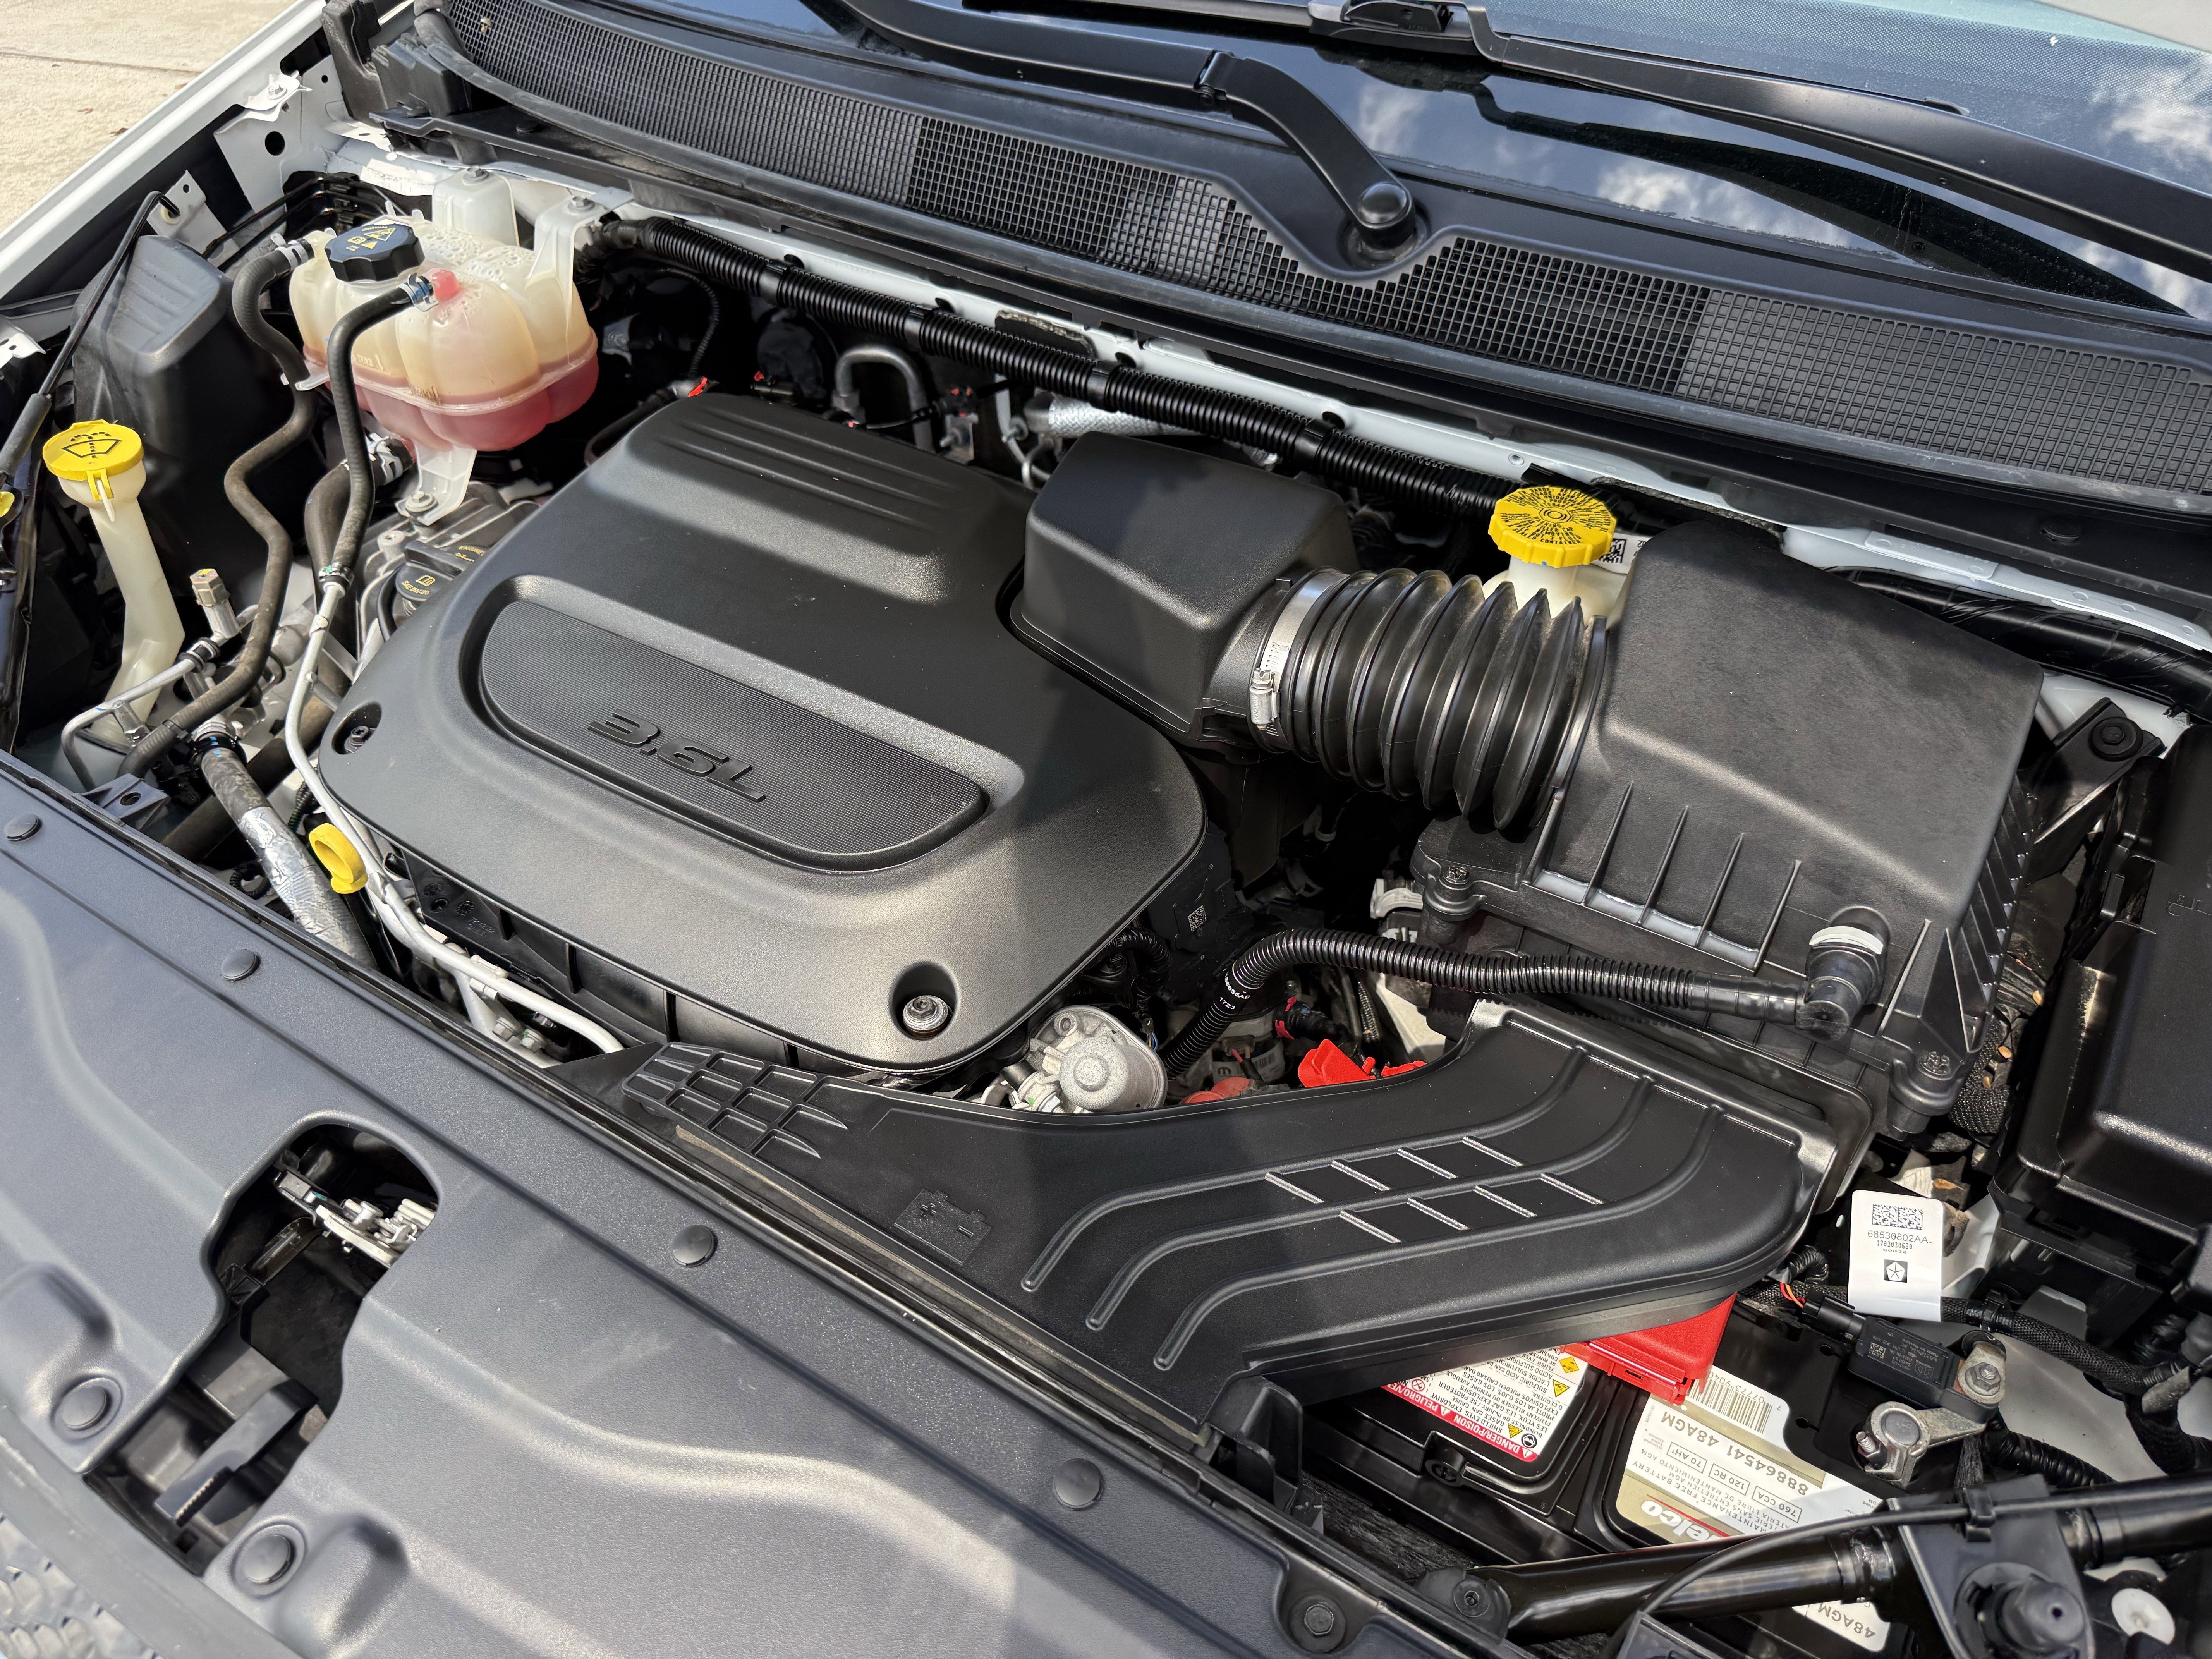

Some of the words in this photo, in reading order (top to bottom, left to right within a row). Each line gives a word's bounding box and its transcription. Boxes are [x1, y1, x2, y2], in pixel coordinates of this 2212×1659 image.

[587, 709, 766, 803] 3.6L
[1877, 1240, 1913, 1249] 1703030620
[1494, 1364, 1505, 1372] CAN
[1537, 1360, 1554, 1371] FLUSH
[1462, 1372, 1482, 1385] GASES
[1476, 1371, 1498, 1385] CAUSAR
[1506, 1370, 1520, 1379] ACID
[1471, 1383, 1491, 1397] RENDRE
[1483, 1382, 1495, 1391] LOS
[1499, 1383, 1520, 1396] PUEDEN
[1520, 1377, 1547, 1393] SULFURIC
[1387, 1382, 1438, 1411] PELIGRO/VE
[1460, 1385, 1491, 1405] EXPLOSIFS
[1735, 1385, 1764, 1403] 07773
[1431, 1392, 1462, 1412] EXPLOSIVE
[1451, 1396, 1469, 1408] CAUSE
[1491, 1401, 1504, 1411] GAZ
[1501, 1399, 1525, 1413] BLESSER
[1515, 1398, 1527, 1407] LOS
[1521, 1394, 1558, 1415] EXPLOSIVOS
[1471, 1406, 1483, 1415] CAN
[1505, 1408, 1516, 1417] LES
[1528, 1404, 1554, 1420] PROTEJA
[1484, 1413, 1504, 1426] GASES
[1526, 1411, 1551, 1426] PEUVENT
[1480, 1419, 1502, 1433] SHIELD
[1511, 1419, 1542, 1438] BLINDNESS
[1536, 1424, 1547, 1433] LES
[1661, 1412, 1718, 1446] 48AGM
[1454, 1415, 1520, 1453] DANGER/POISON
[1691, 1457, 1701, 1467] 70
[1632, 1461, 1672, 1484] BATTERY
[1659, 1459, 1721, 1495] MANTENIMIENTO
[1714, 1469, 1726, 1480] RC
[1727, 1445, 1807, 1495] 88864541
[1669, 1472, 1685, 1483] AGM
[1728, 1477, 1744, 1489] 120
[1675, 1482, 1697, 1498] FREE
[1687, 1481, 1729, 1507] ENTRETIEN
[1724, 1493, 1734, 1502] DE
[1758, 1491, 1776, 1505] CCA
[1733, 1505, 1752, 1519] SANS
[1737, 1499, 1760, 1515] LIBRE
[1779, 1503, 1796, 1517] 760
[1641, 1501, 1719, 1543] elco
[1818, 1601, 1875, 1638] 48AGM
